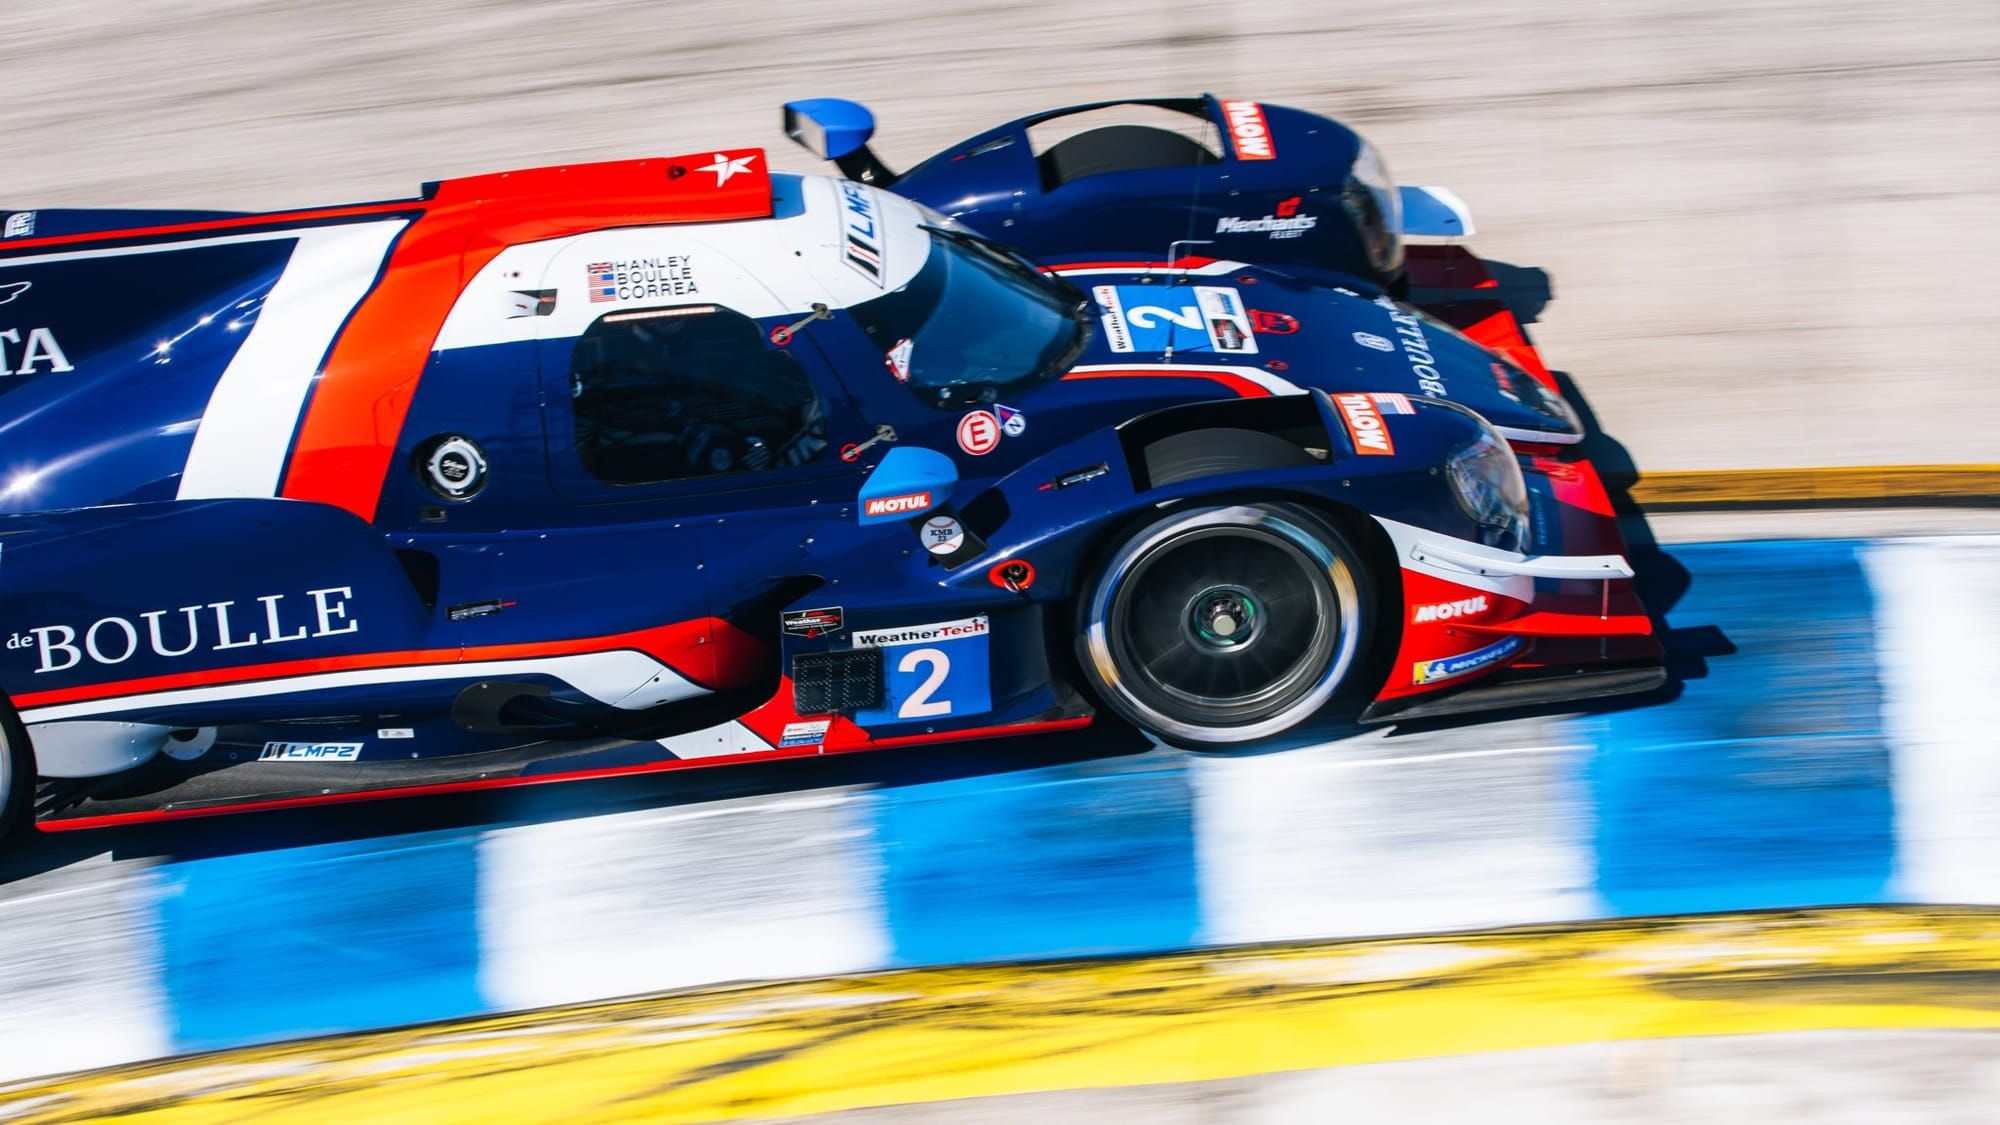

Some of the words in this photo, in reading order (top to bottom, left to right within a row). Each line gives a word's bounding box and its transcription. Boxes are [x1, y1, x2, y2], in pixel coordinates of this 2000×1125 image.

[615, 255, 691, 272] HANLEY
[616, 267, 692, 285] BOULLE
[618, 281, 699, 300] CORREA
[1126, 305, 1206, 330] 2
[970, 420, 988, 446] E
[1337, 395, 1388, 451] MOTUL
[868, 495, 929, 514] MOTUL
[1414, 595, 1488, 623] MOTUL
[859, 620, 986, 645] WeatherTech
[898, 648, 952, 719] 2
[287, 745, 356, 758] LMP2
